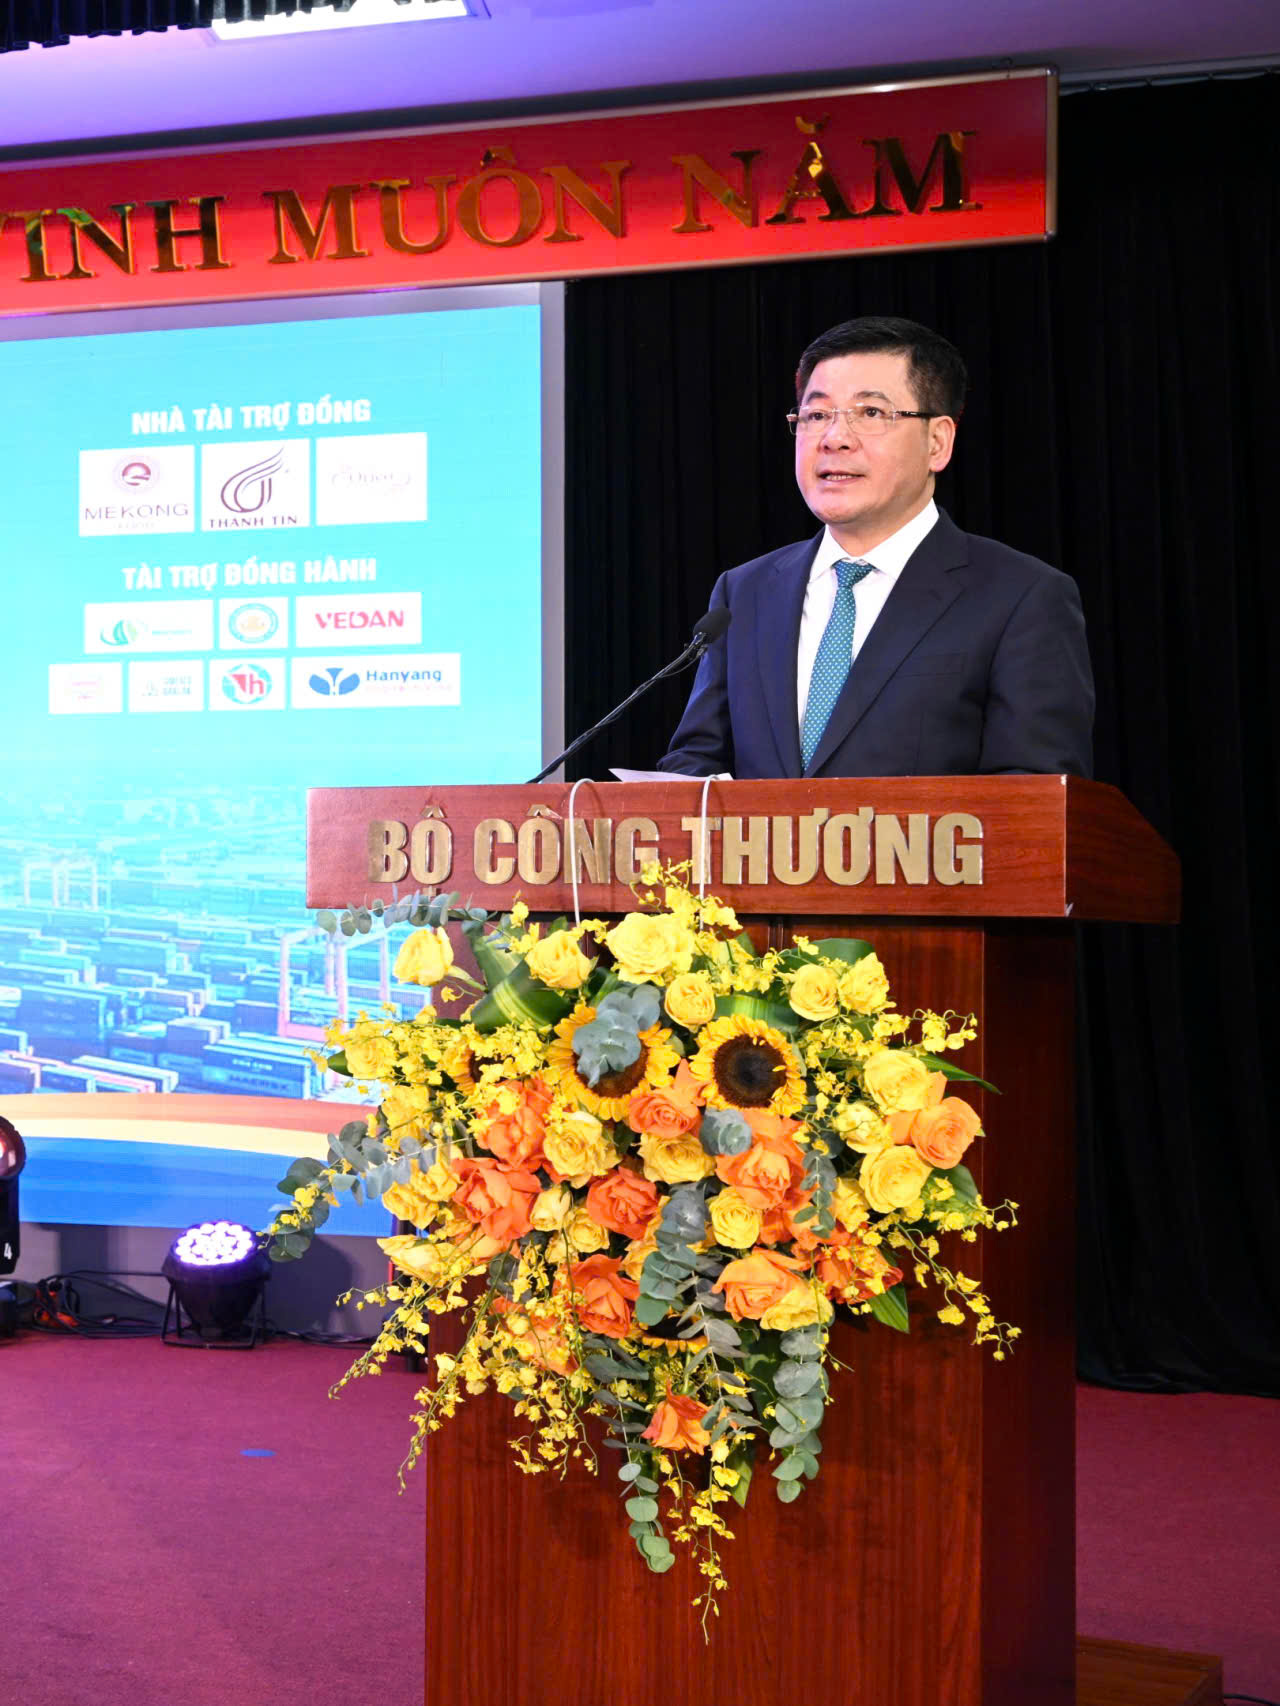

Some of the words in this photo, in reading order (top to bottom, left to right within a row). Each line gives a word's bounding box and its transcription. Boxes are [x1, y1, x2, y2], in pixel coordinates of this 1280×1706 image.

[261, 146, 634, 264] MUÔN
[670, 111, 985, 233] NĂM
[131, 404, 187, 435] NHÀ
[191, 401, 233, 432] TÀI
[240, 400, 292, 432] TRỢ
[84, 503, 189, 521] MEKONG
[120, 562, 163, 591] TÀI
[168, 561, 219, 592] TRỢ
[304, 554, 377, 584] HÀNH
[314, 609, 405, 630] VEDAN
[365, 669, 443, 683] Hanyang
[368, 804, 453, 896] BỘ
[473, 803, 660, 886] CÔNG
[680, 806, 985, 887] THƯƠNG
[4, 1243, 13, 1260] 4
